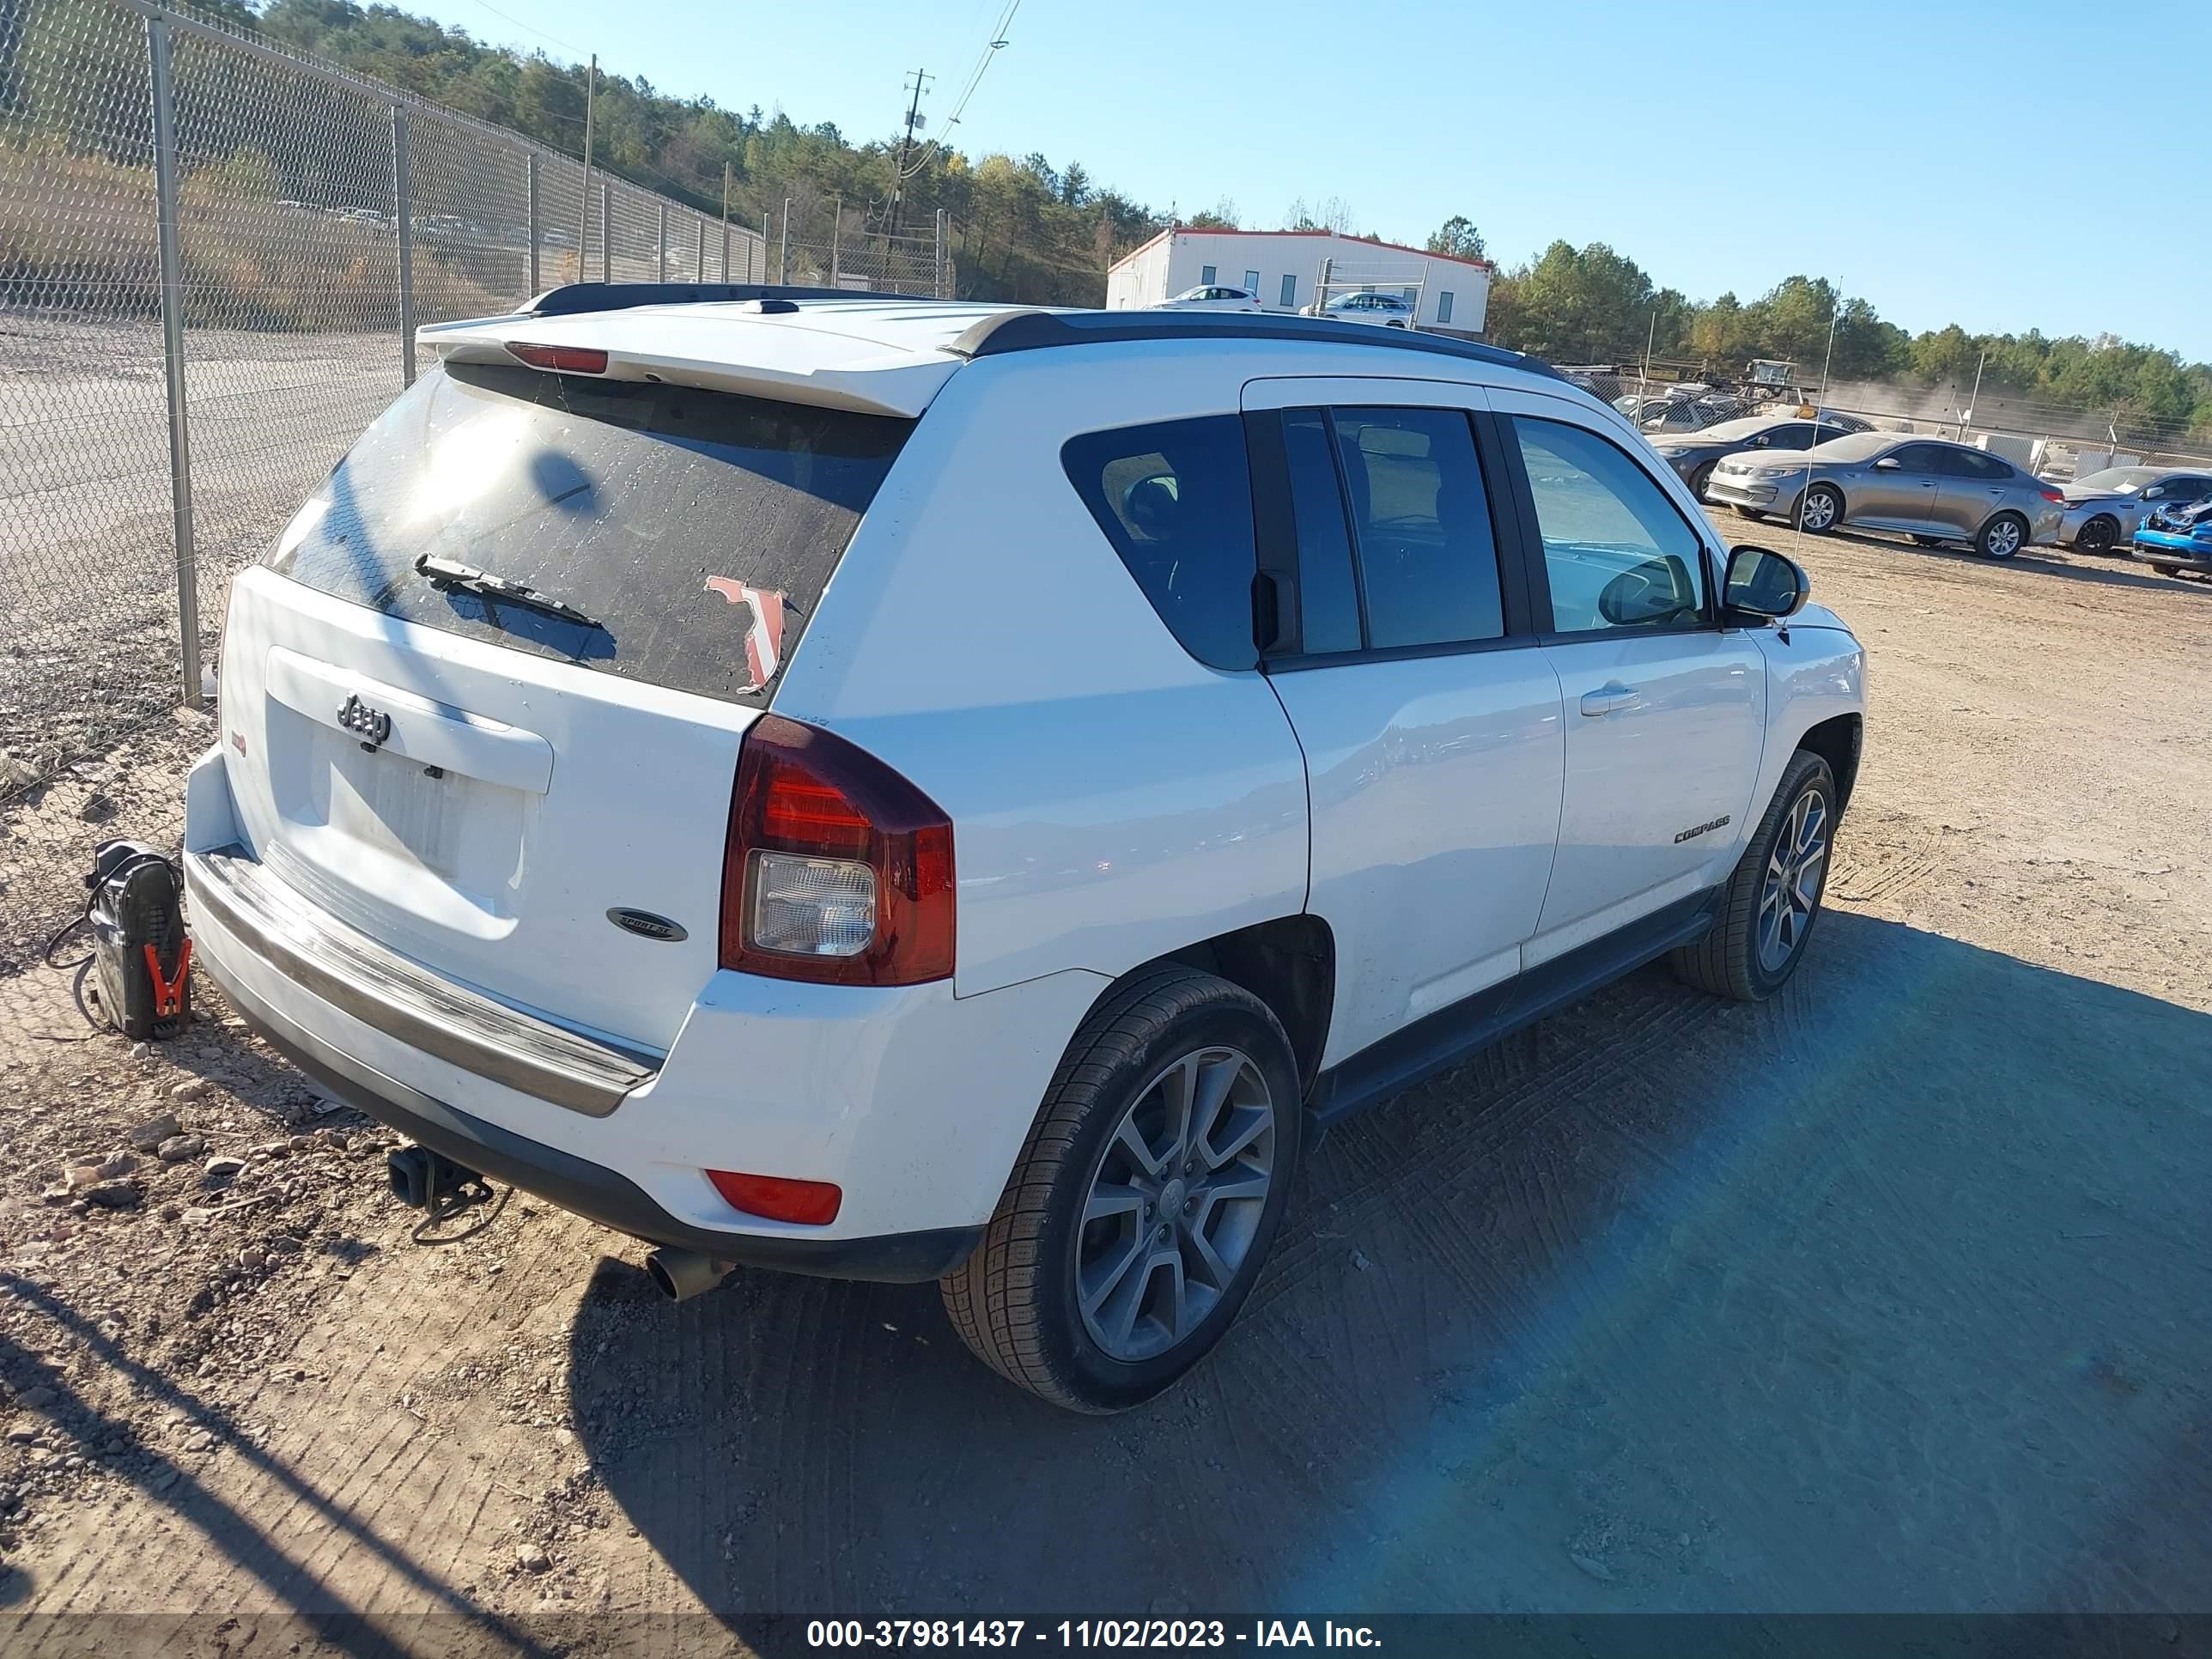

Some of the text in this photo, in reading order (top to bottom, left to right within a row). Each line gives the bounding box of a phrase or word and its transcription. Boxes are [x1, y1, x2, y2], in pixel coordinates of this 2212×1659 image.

[335, 690, 392, 746] Jeep
[1674, 814, 1731, 845] COMPASS
[619, 915, 654, 931] SPORT
